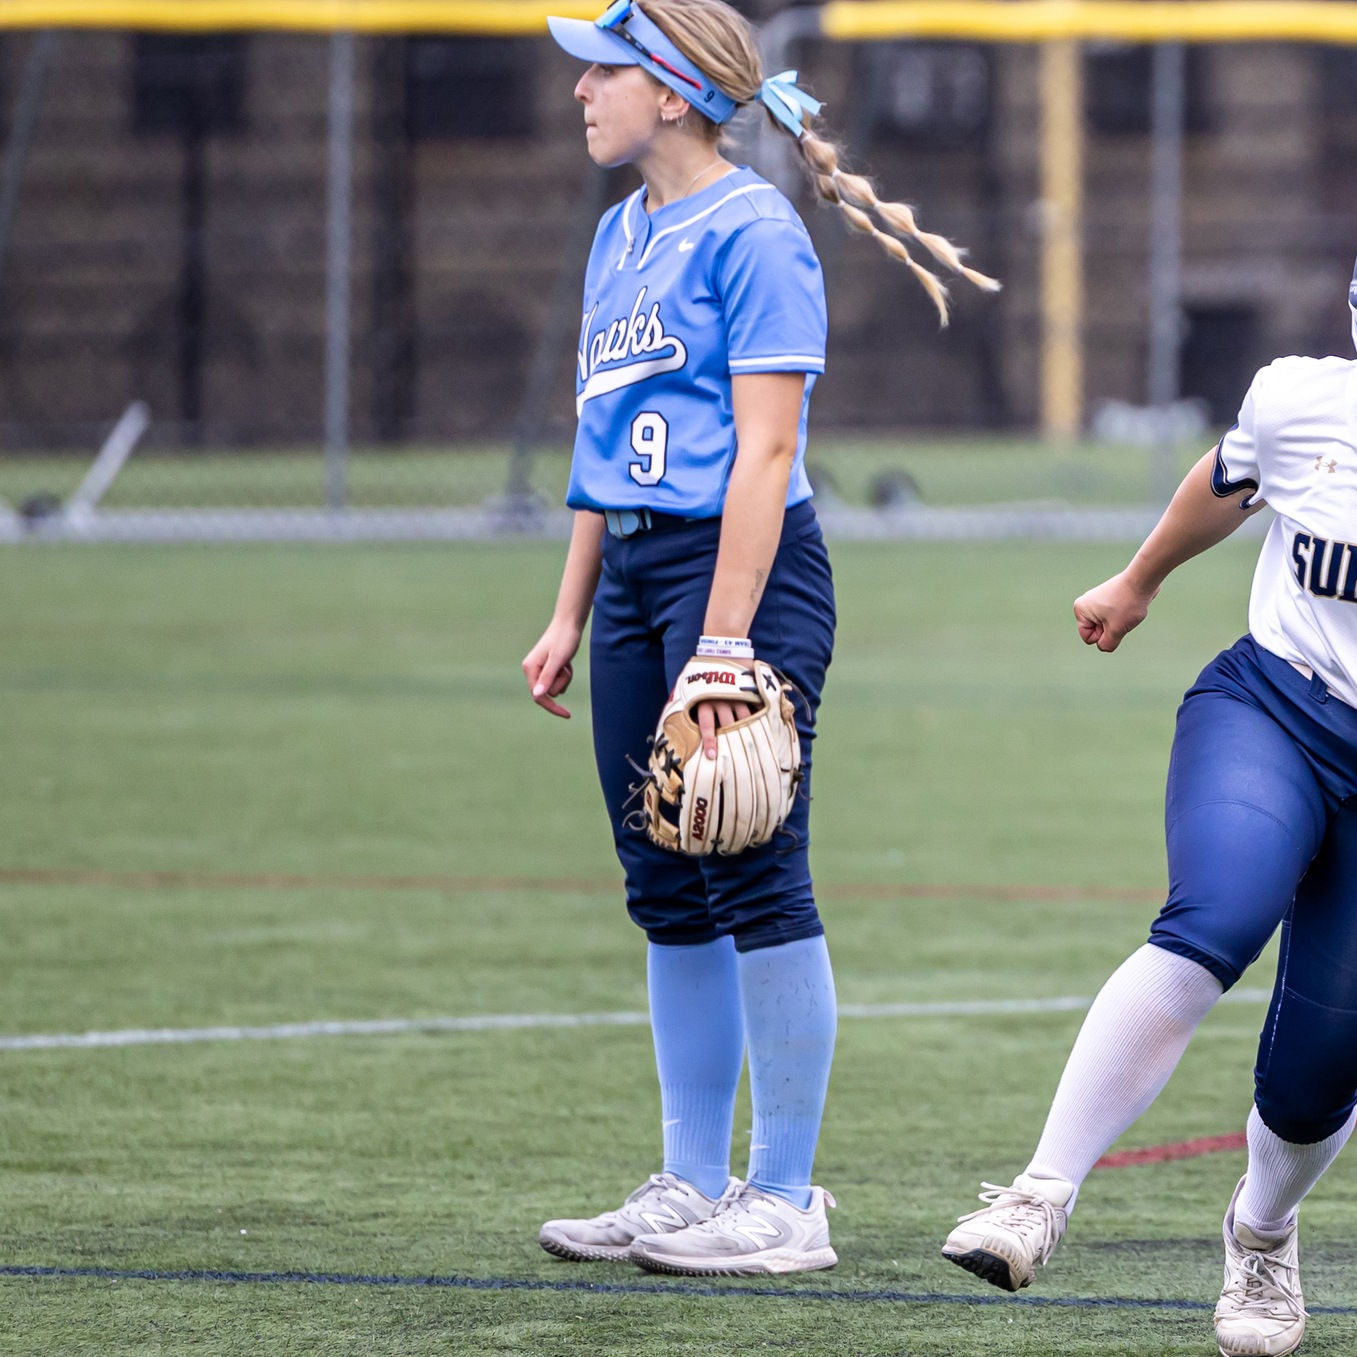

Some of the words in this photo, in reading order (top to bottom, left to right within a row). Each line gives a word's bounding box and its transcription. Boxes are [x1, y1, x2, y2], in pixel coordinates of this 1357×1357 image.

[703, 90, 716, 104] 9
[629, 411, 669, 487] 9
[687, 671, 736, 685] Wilson
[692, 797, 708, 841] A2000
